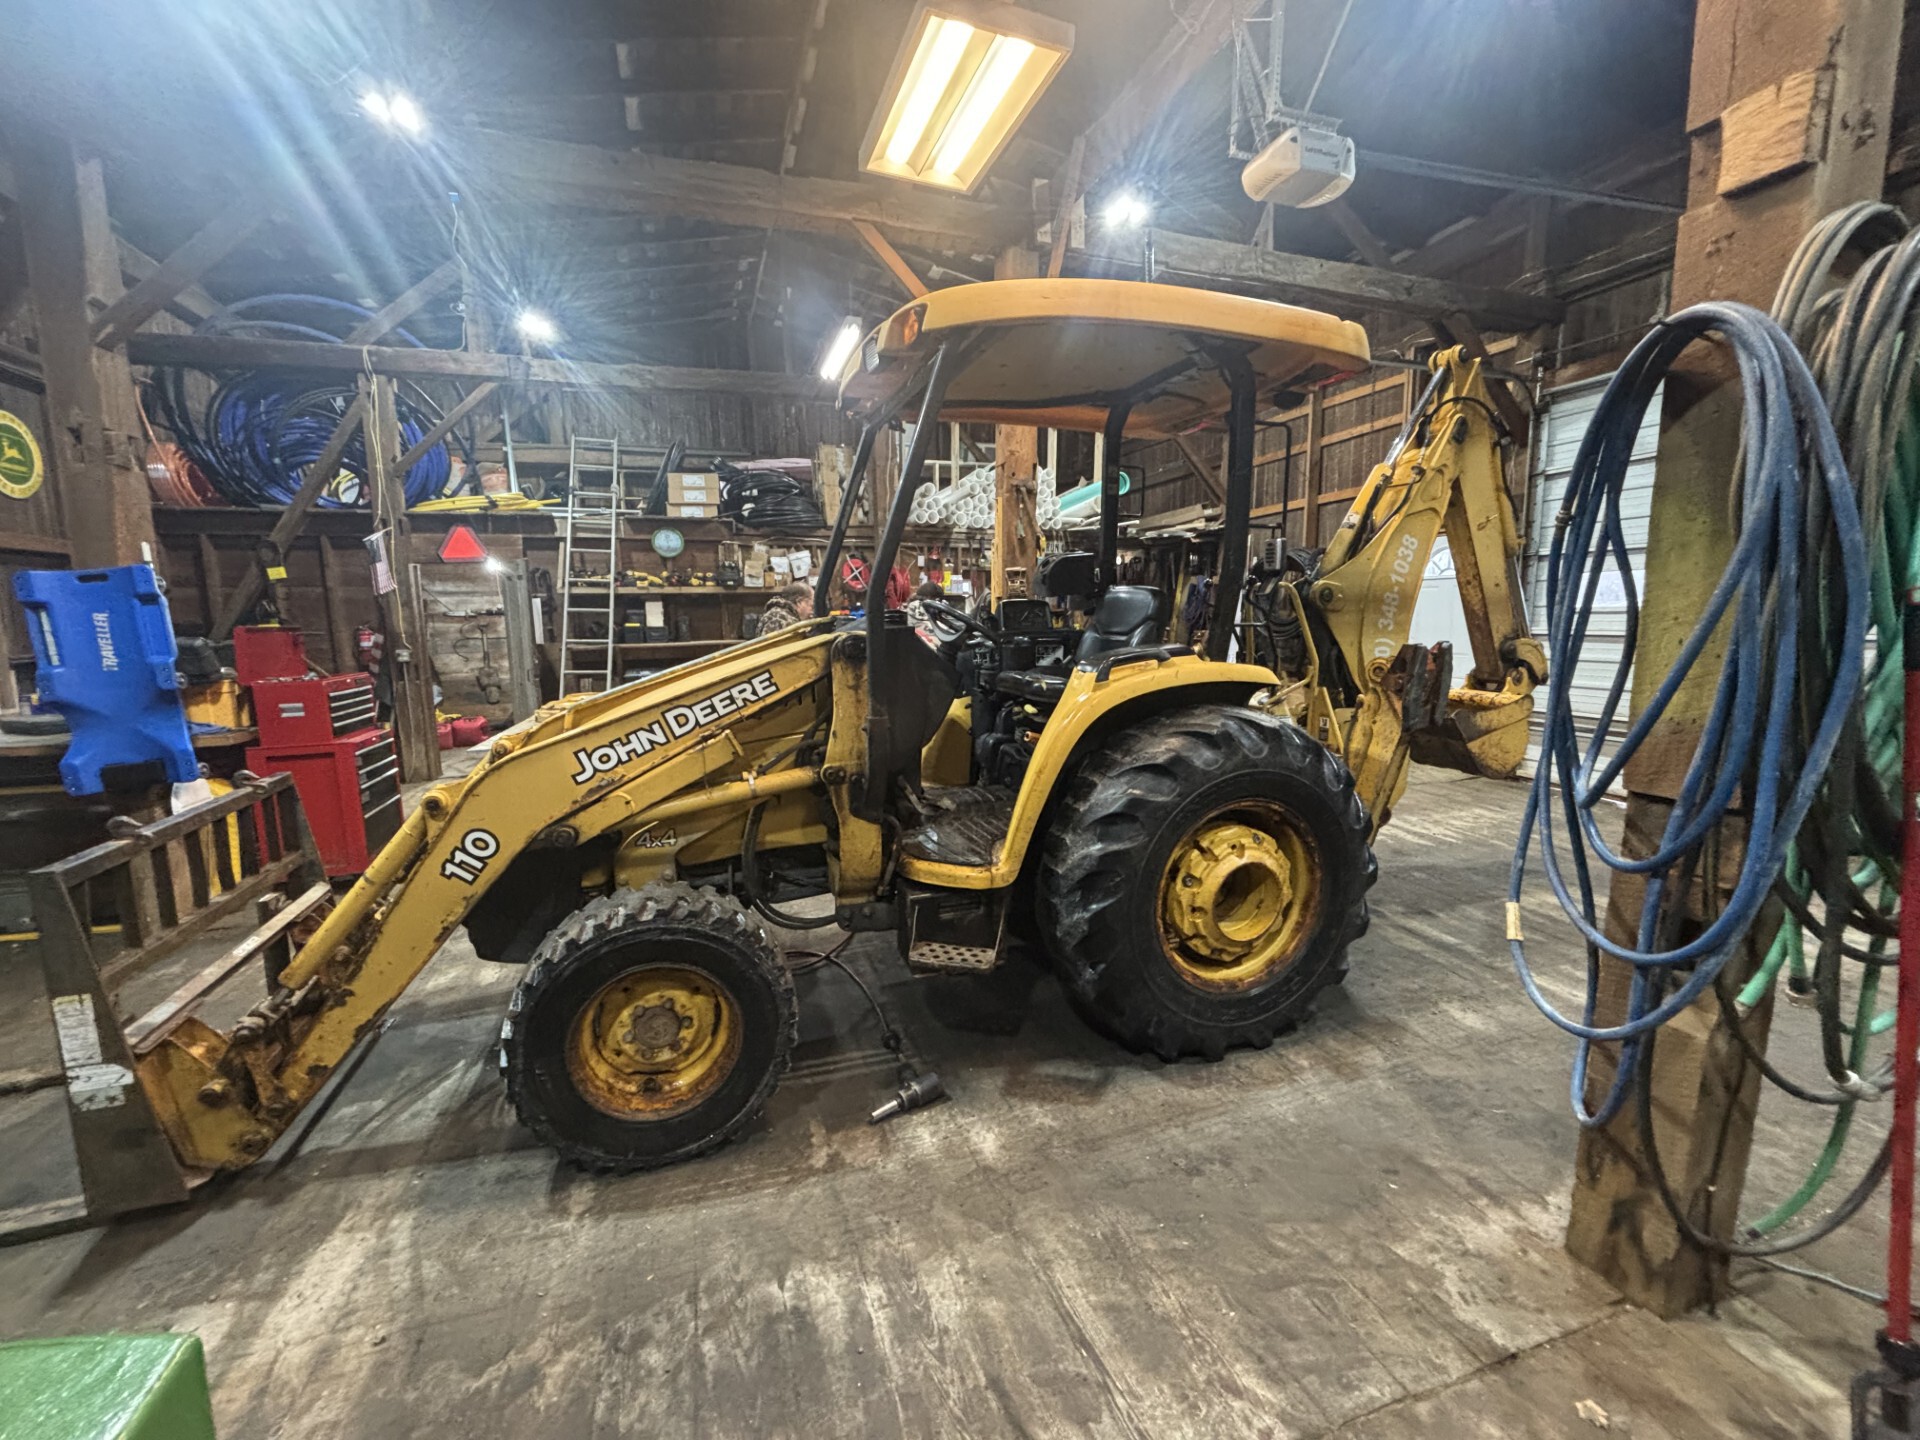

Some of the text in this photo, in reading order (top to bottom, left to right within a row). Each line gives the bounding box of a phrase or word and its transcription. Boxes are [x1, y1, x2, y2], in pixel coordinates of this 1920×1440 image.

[92, 612, 118, 671] TRAVELLER
[572, 669, 780, 785] JOHN DEERE
[441, 828, 500, 886] 110
[635, 828, 677, 848] 4x4
